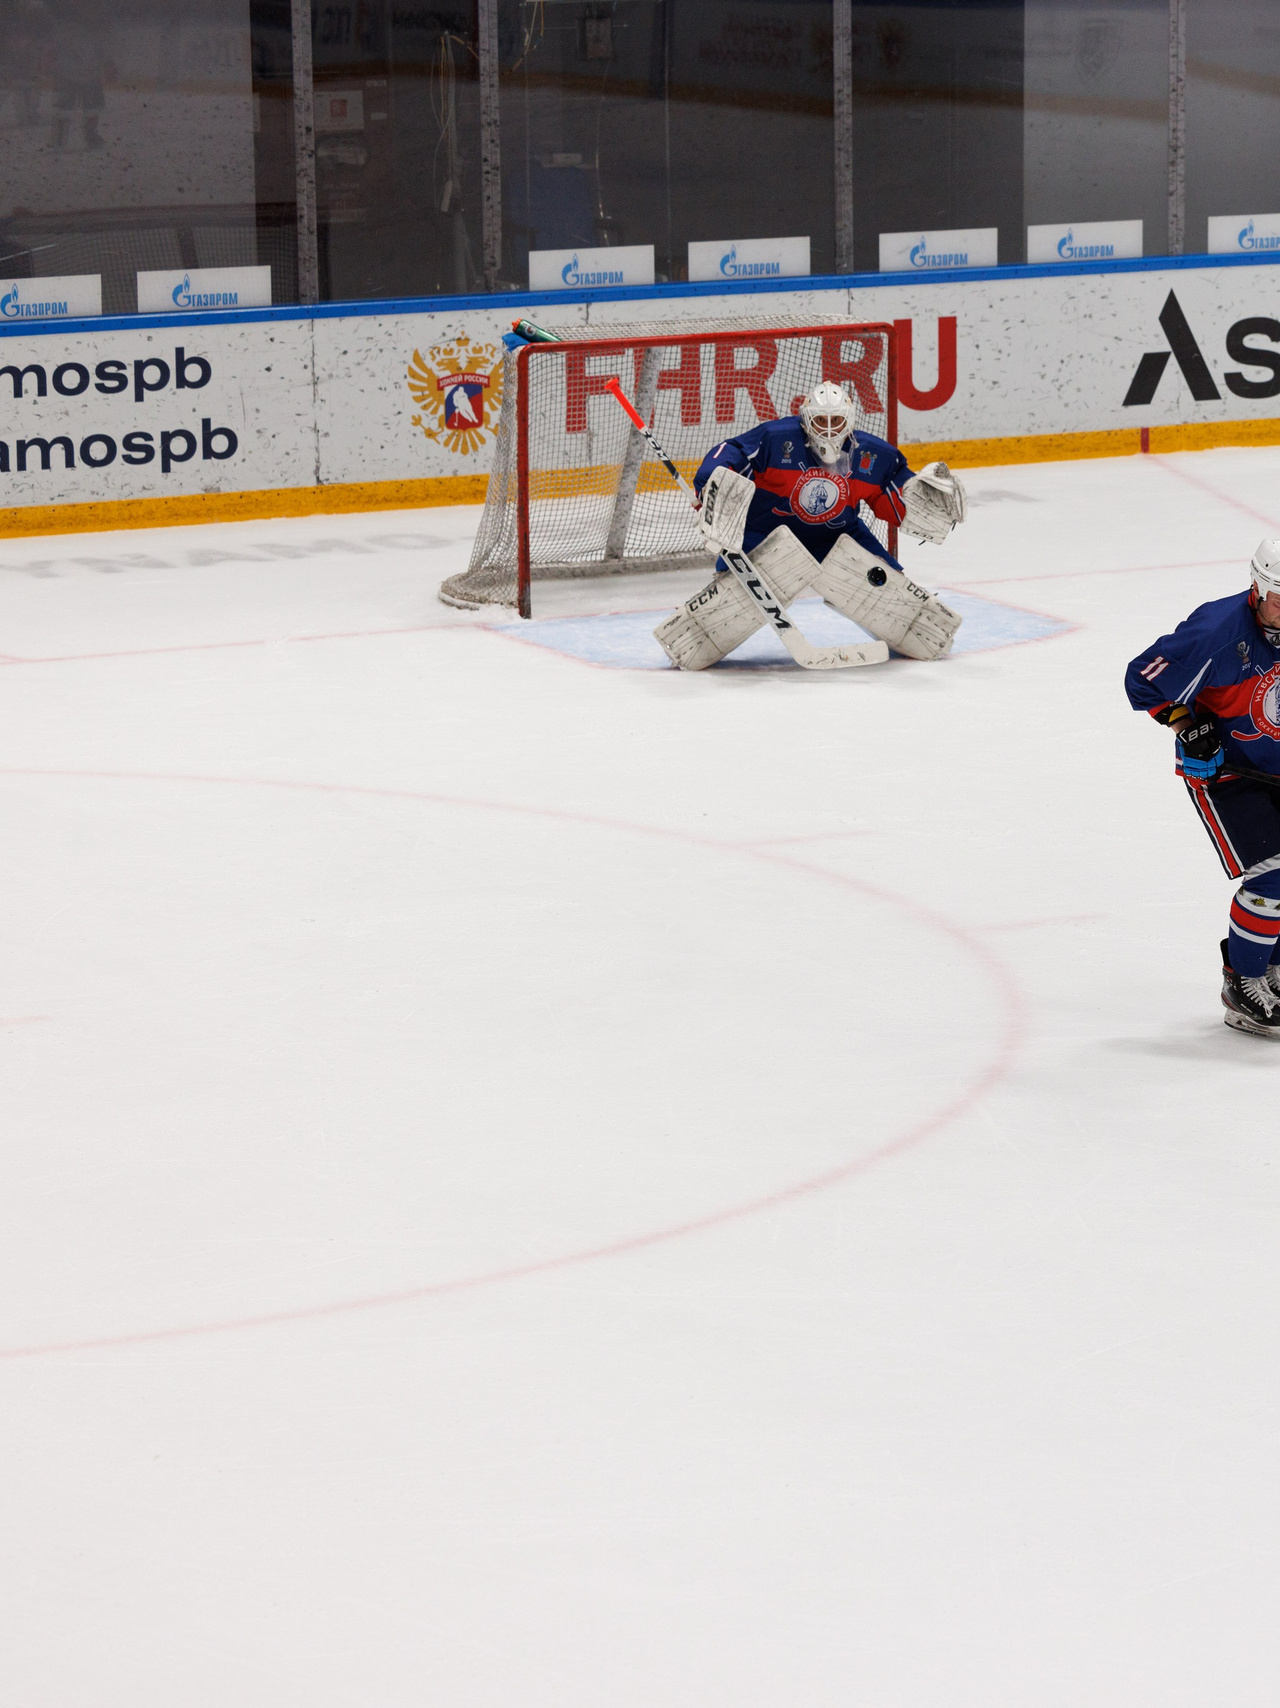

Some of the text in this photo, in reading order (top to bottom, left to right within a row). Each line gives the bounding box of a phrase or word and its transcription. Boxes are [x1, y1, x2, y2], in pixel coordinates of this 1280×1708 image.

[580, 270, 624, 285] ГАЗПРОМ
[20, 301, 68, 316] ГАЗПРОМ
[191, 292, 238, 307] ГАЗПРОМ
[464, 374, 489, 385] РОССИИ
[705, 480, 720, 526] CCM
[688, 585, 719, 612] CCM
[727, 552, 793, 629] CCM
[906, 582, 930, 603] CCM
[1140, 655, 1170, 682] 11
